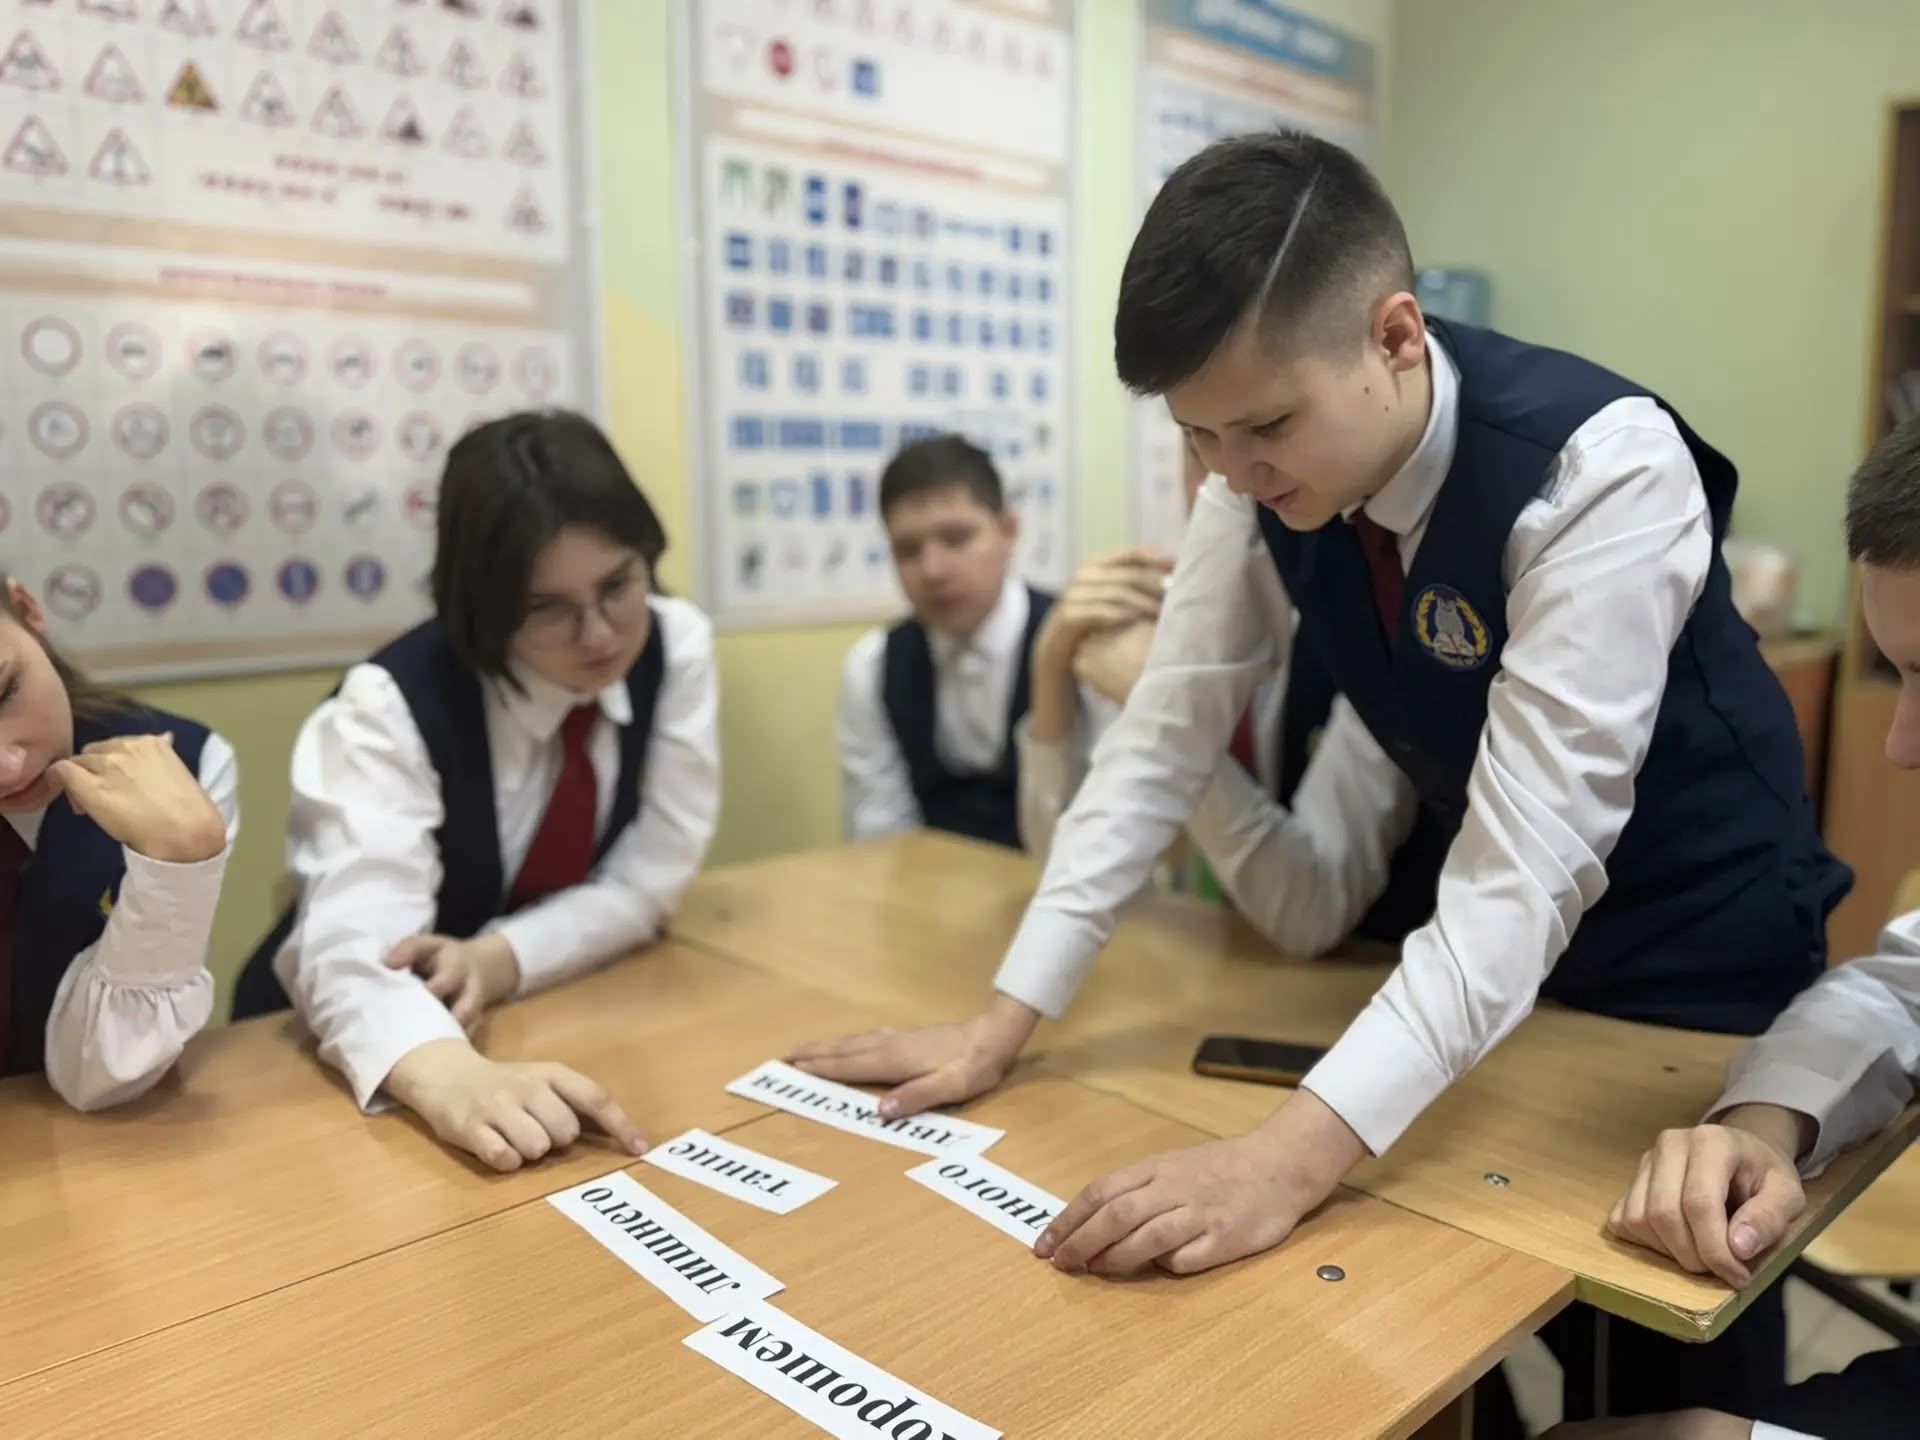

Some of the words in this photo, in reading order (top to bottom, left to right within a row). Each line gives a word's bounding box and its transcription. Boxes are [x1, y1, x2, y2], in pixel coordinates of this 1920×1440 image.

[668, 1142, 792, 1197] танце
[938, 1164, 1055, 1229] дного
[580, 1187, 741, 1294] лишнего
[717, 1316, 959, 1440] орошем
